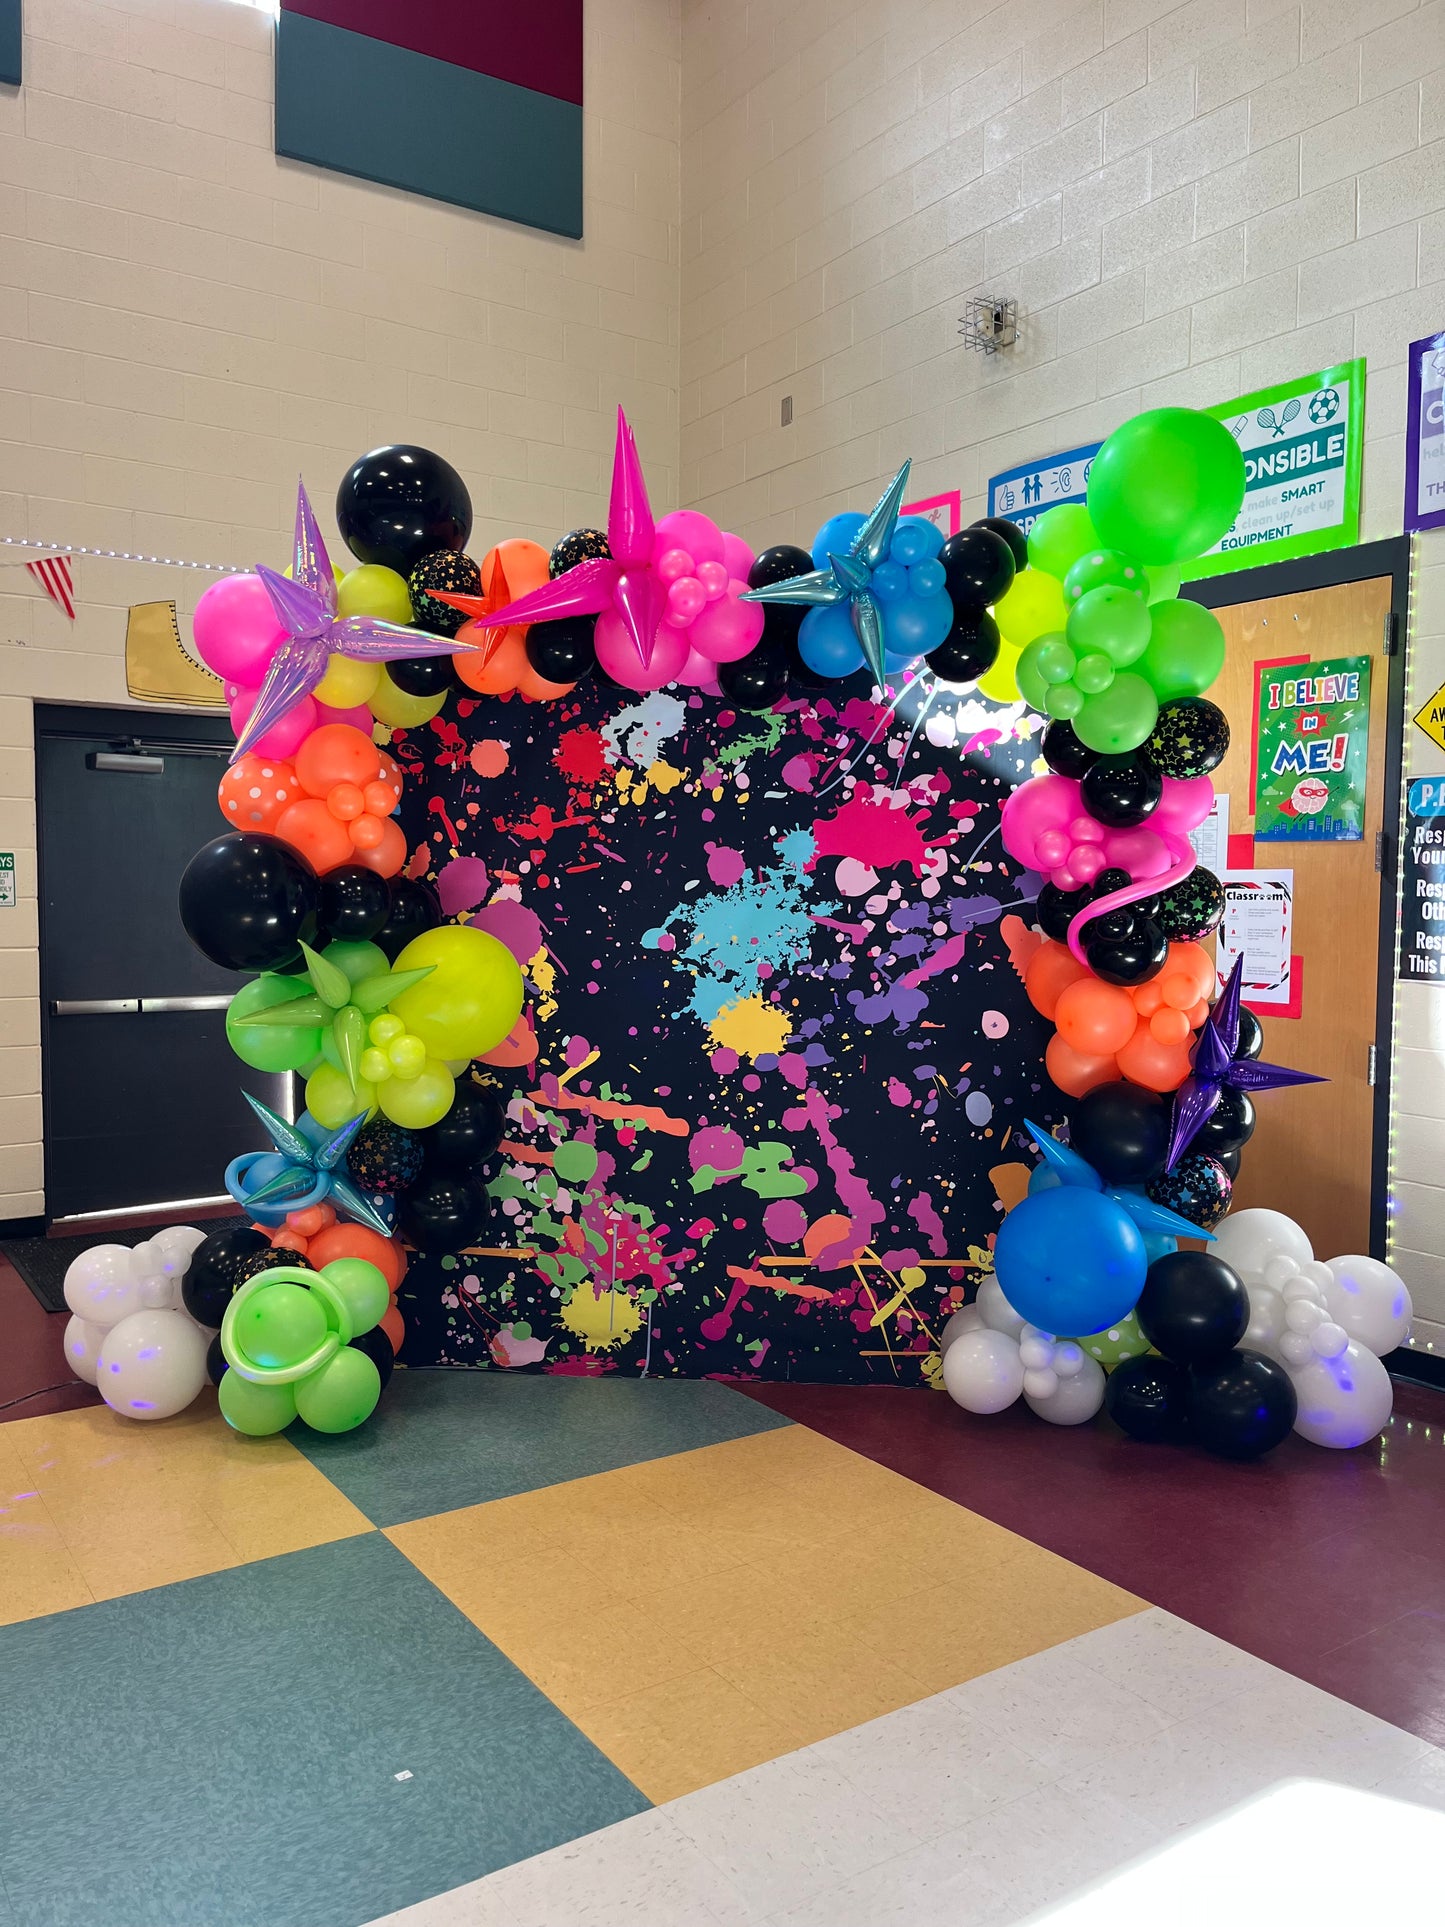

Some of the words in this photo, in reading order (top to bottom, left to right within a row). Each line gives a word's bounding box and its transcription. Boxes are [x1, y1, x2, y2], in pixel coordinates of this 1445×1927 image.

[1247, 495, 1278, 511] make
[1281, 480, 1326, 503] SMART
[1242, 514, 1273, 529] clean
[1319, 499, 1335, 512] up
[1268, 683, 1281, 710] I
[1283, 672, 1360, 707] BELIEVE
[1302, 716, 1318, 730] IN
[1270, 733, 1349, 775] ME!
[0, 857, 12, 868] YS
[1409, 954, 1437, 974] This
